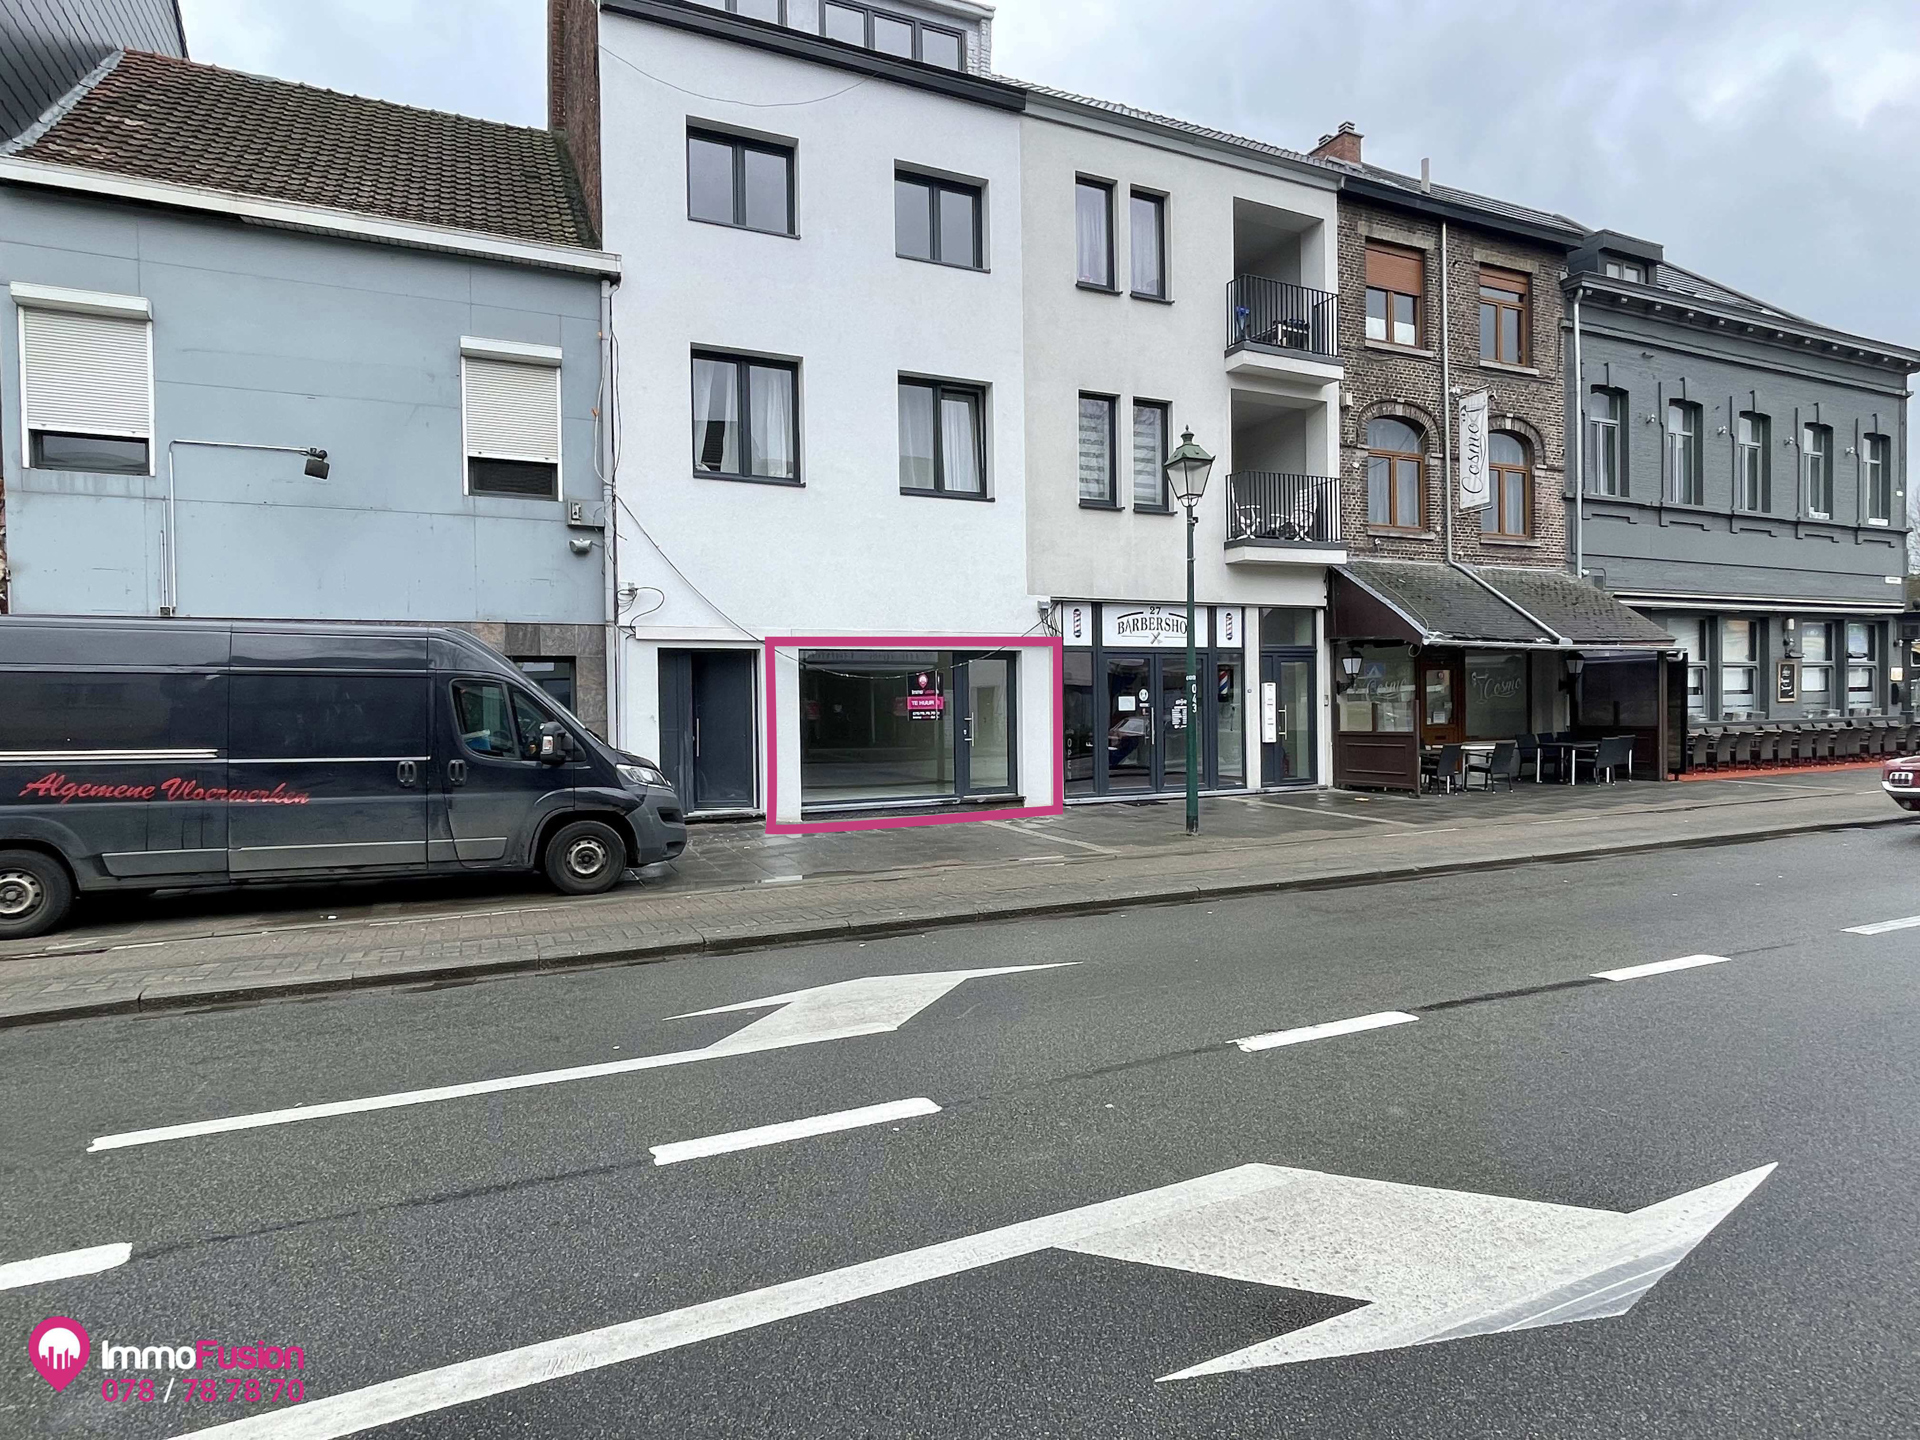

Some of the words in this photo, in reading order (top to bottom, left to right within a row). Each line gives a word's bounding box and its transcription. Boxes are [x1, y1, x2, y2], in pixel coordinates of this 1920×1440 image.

[1461, 422, 1485, 494] Cosmo
[1149, 606, 1162, 615] 27
[1117, 616, 1188, 635] BARBERSHO
[19, 772, 156, 804] Algemene
[160, 777, 310, 804] Vloerwerken
